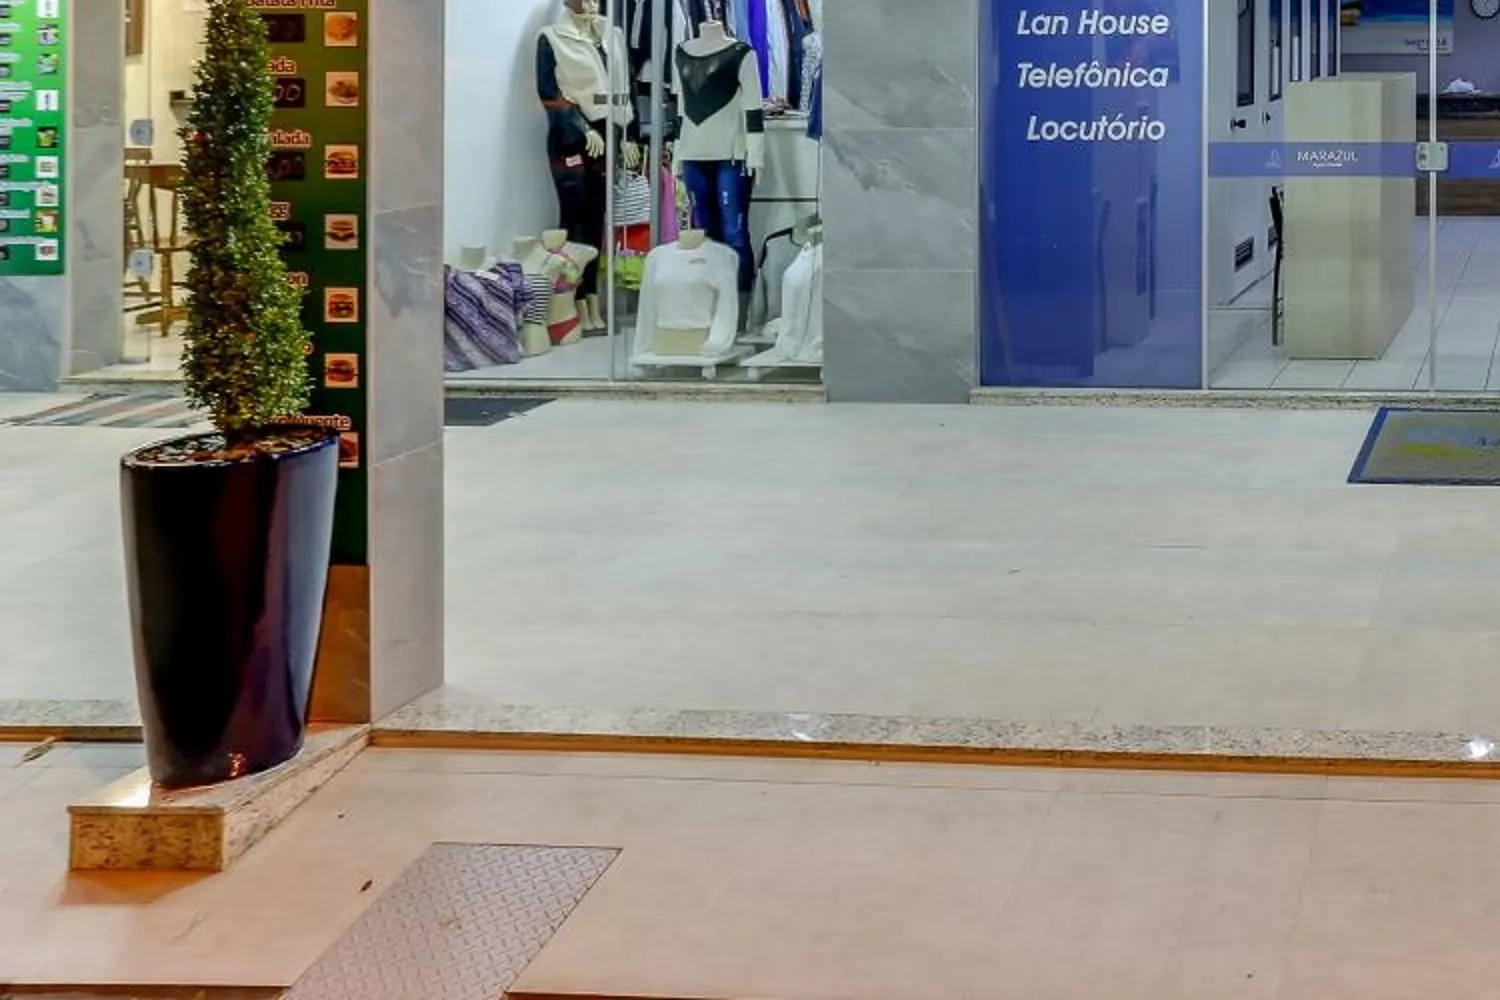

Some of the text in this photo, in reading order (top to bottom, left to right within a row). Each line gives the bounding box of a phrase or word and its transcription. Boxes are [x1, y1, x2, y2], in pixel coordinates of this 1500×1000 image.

[1017, 9, 1169, 35] Lan House
[1018, 61, 1169, 88] Telefônica
[1026, 113, 1165, 141] Locutório
